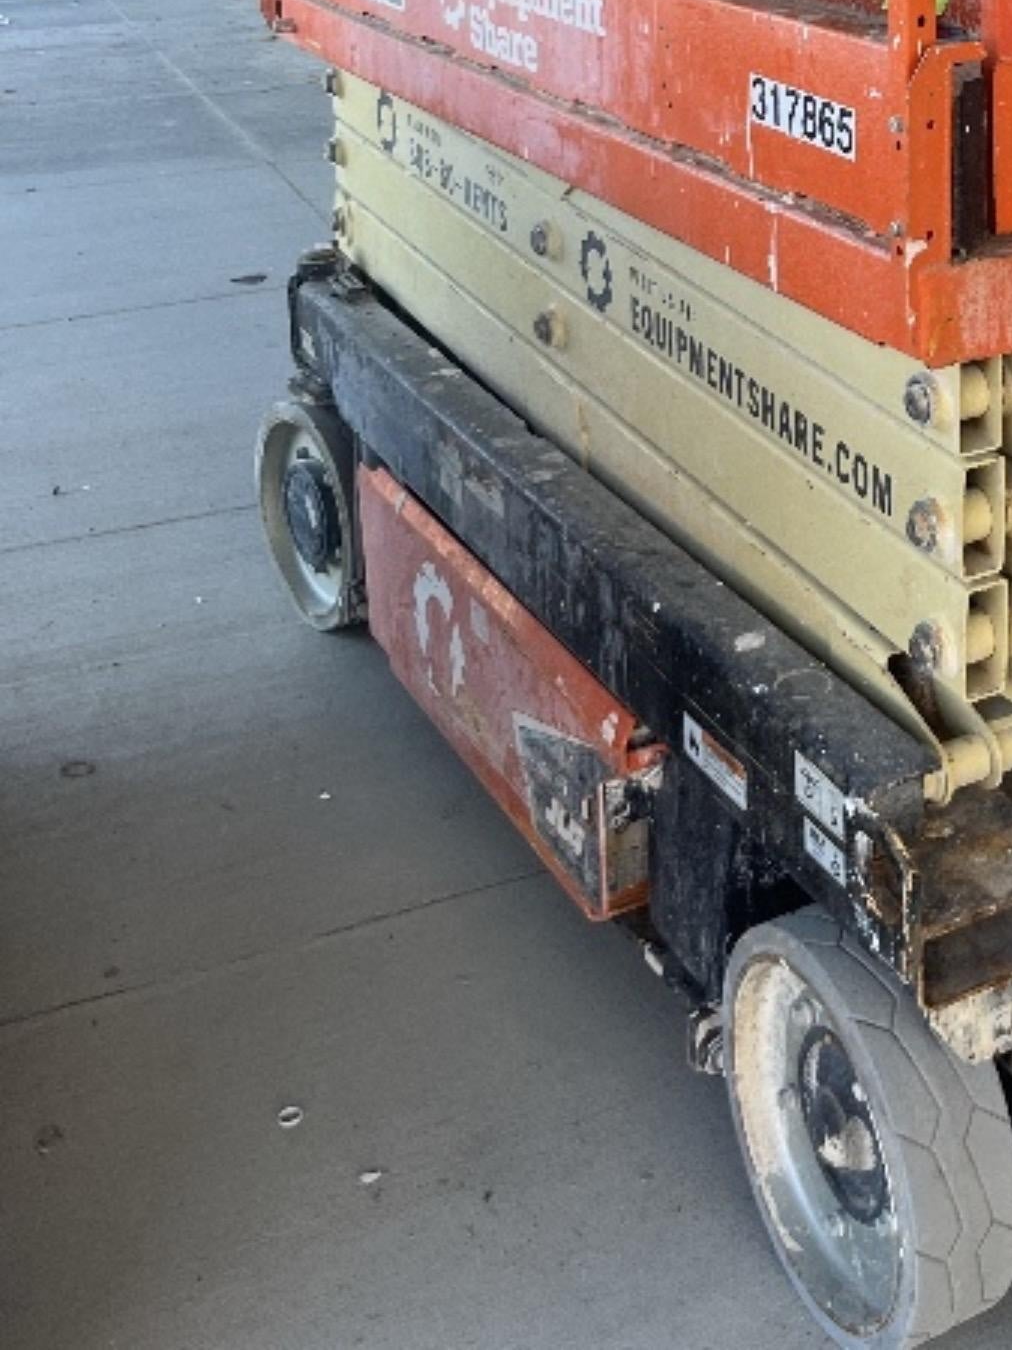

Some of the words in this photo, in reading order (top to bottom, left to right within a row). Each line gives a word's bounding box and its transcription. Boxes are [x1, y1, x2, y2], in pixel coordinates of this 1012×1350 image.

[470, 3, 538, 73] Share
[751, 76, 853, 154] 317865
[631, 295, 893, 517] EQUIPMENTSHARE.COM
